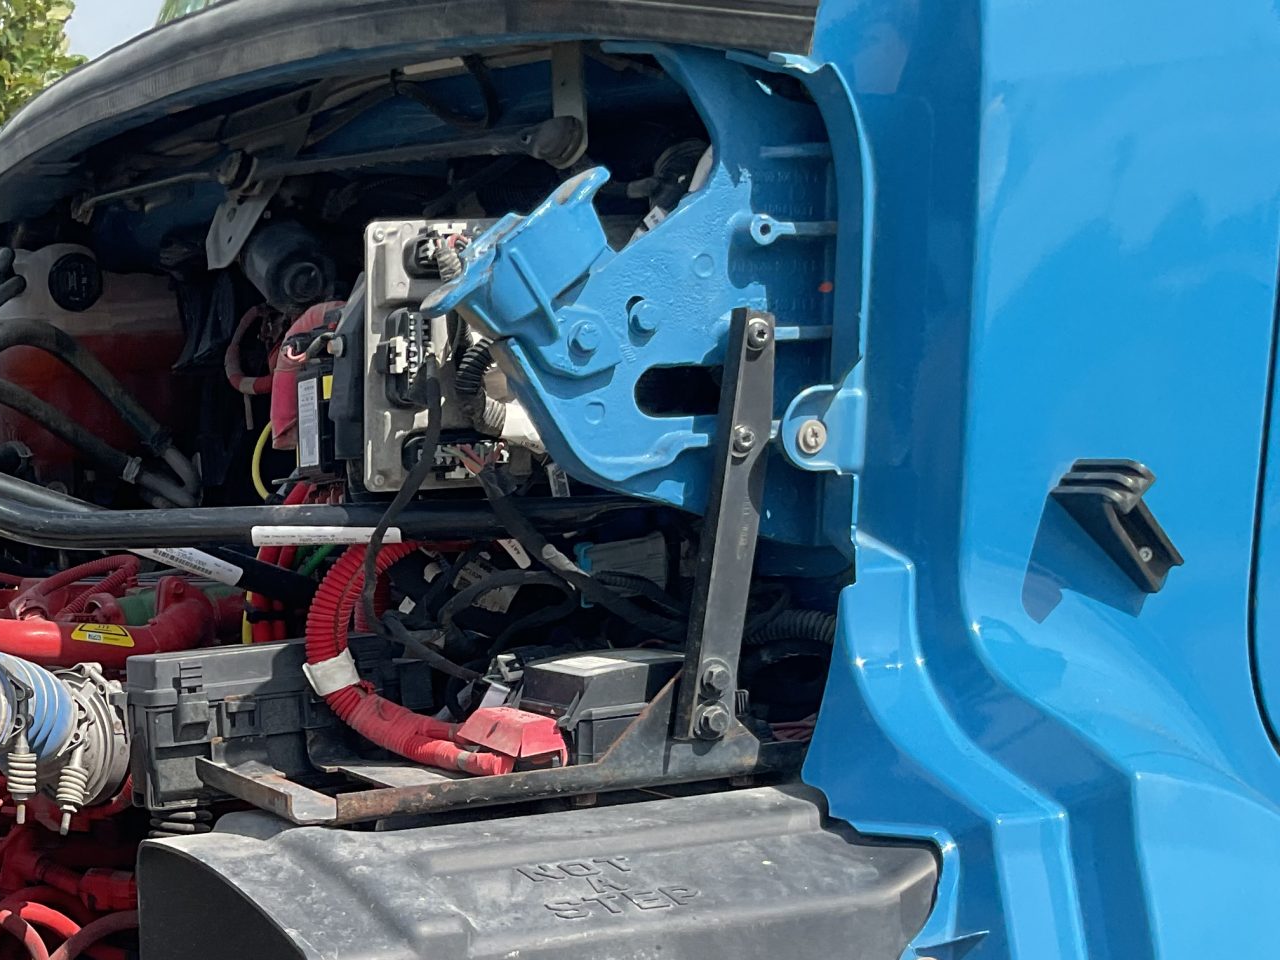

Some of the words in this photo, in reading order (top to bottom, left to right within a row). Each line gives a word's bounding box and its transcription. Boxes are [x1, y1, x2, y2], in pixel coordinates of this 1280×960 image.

[516, 857, 631, 882] NOT
[586, 877, 629, 894] A
[544, 885, 702, 919] STEP
